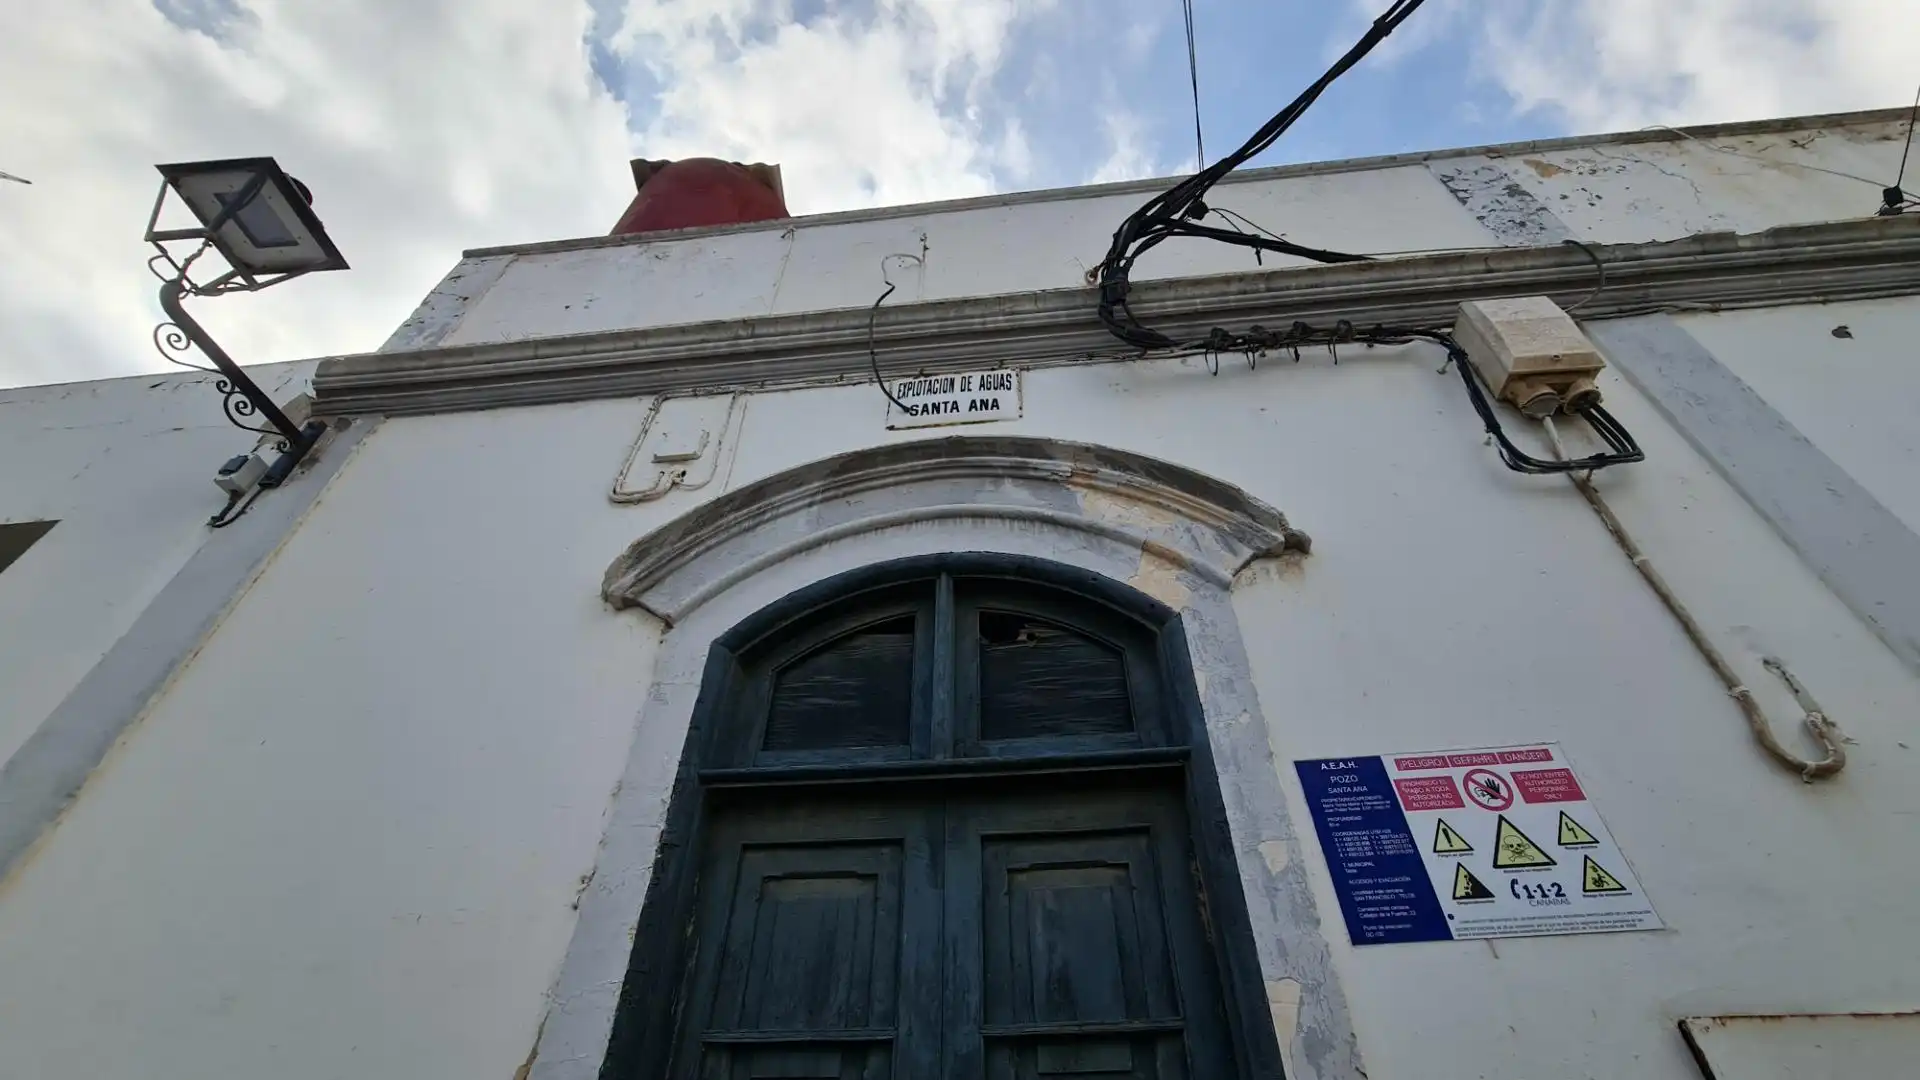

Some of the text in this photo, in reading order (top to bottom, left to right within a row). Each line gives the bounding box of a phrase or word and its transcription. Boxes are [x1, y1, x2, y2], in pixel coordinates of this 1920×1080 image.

[897, 373, 1012, 400] EXPLOTACION DE AGUAS
[909, 398, 1000, 416] SANTA ANA
[1452, 755, 1496, 765] GEFAHR!
[1504, 751, 1547, 761] DANGER!
[1321, 761, 1359, 770] A.E.A.H.
[1330, 774, 1359, 783] POZO
